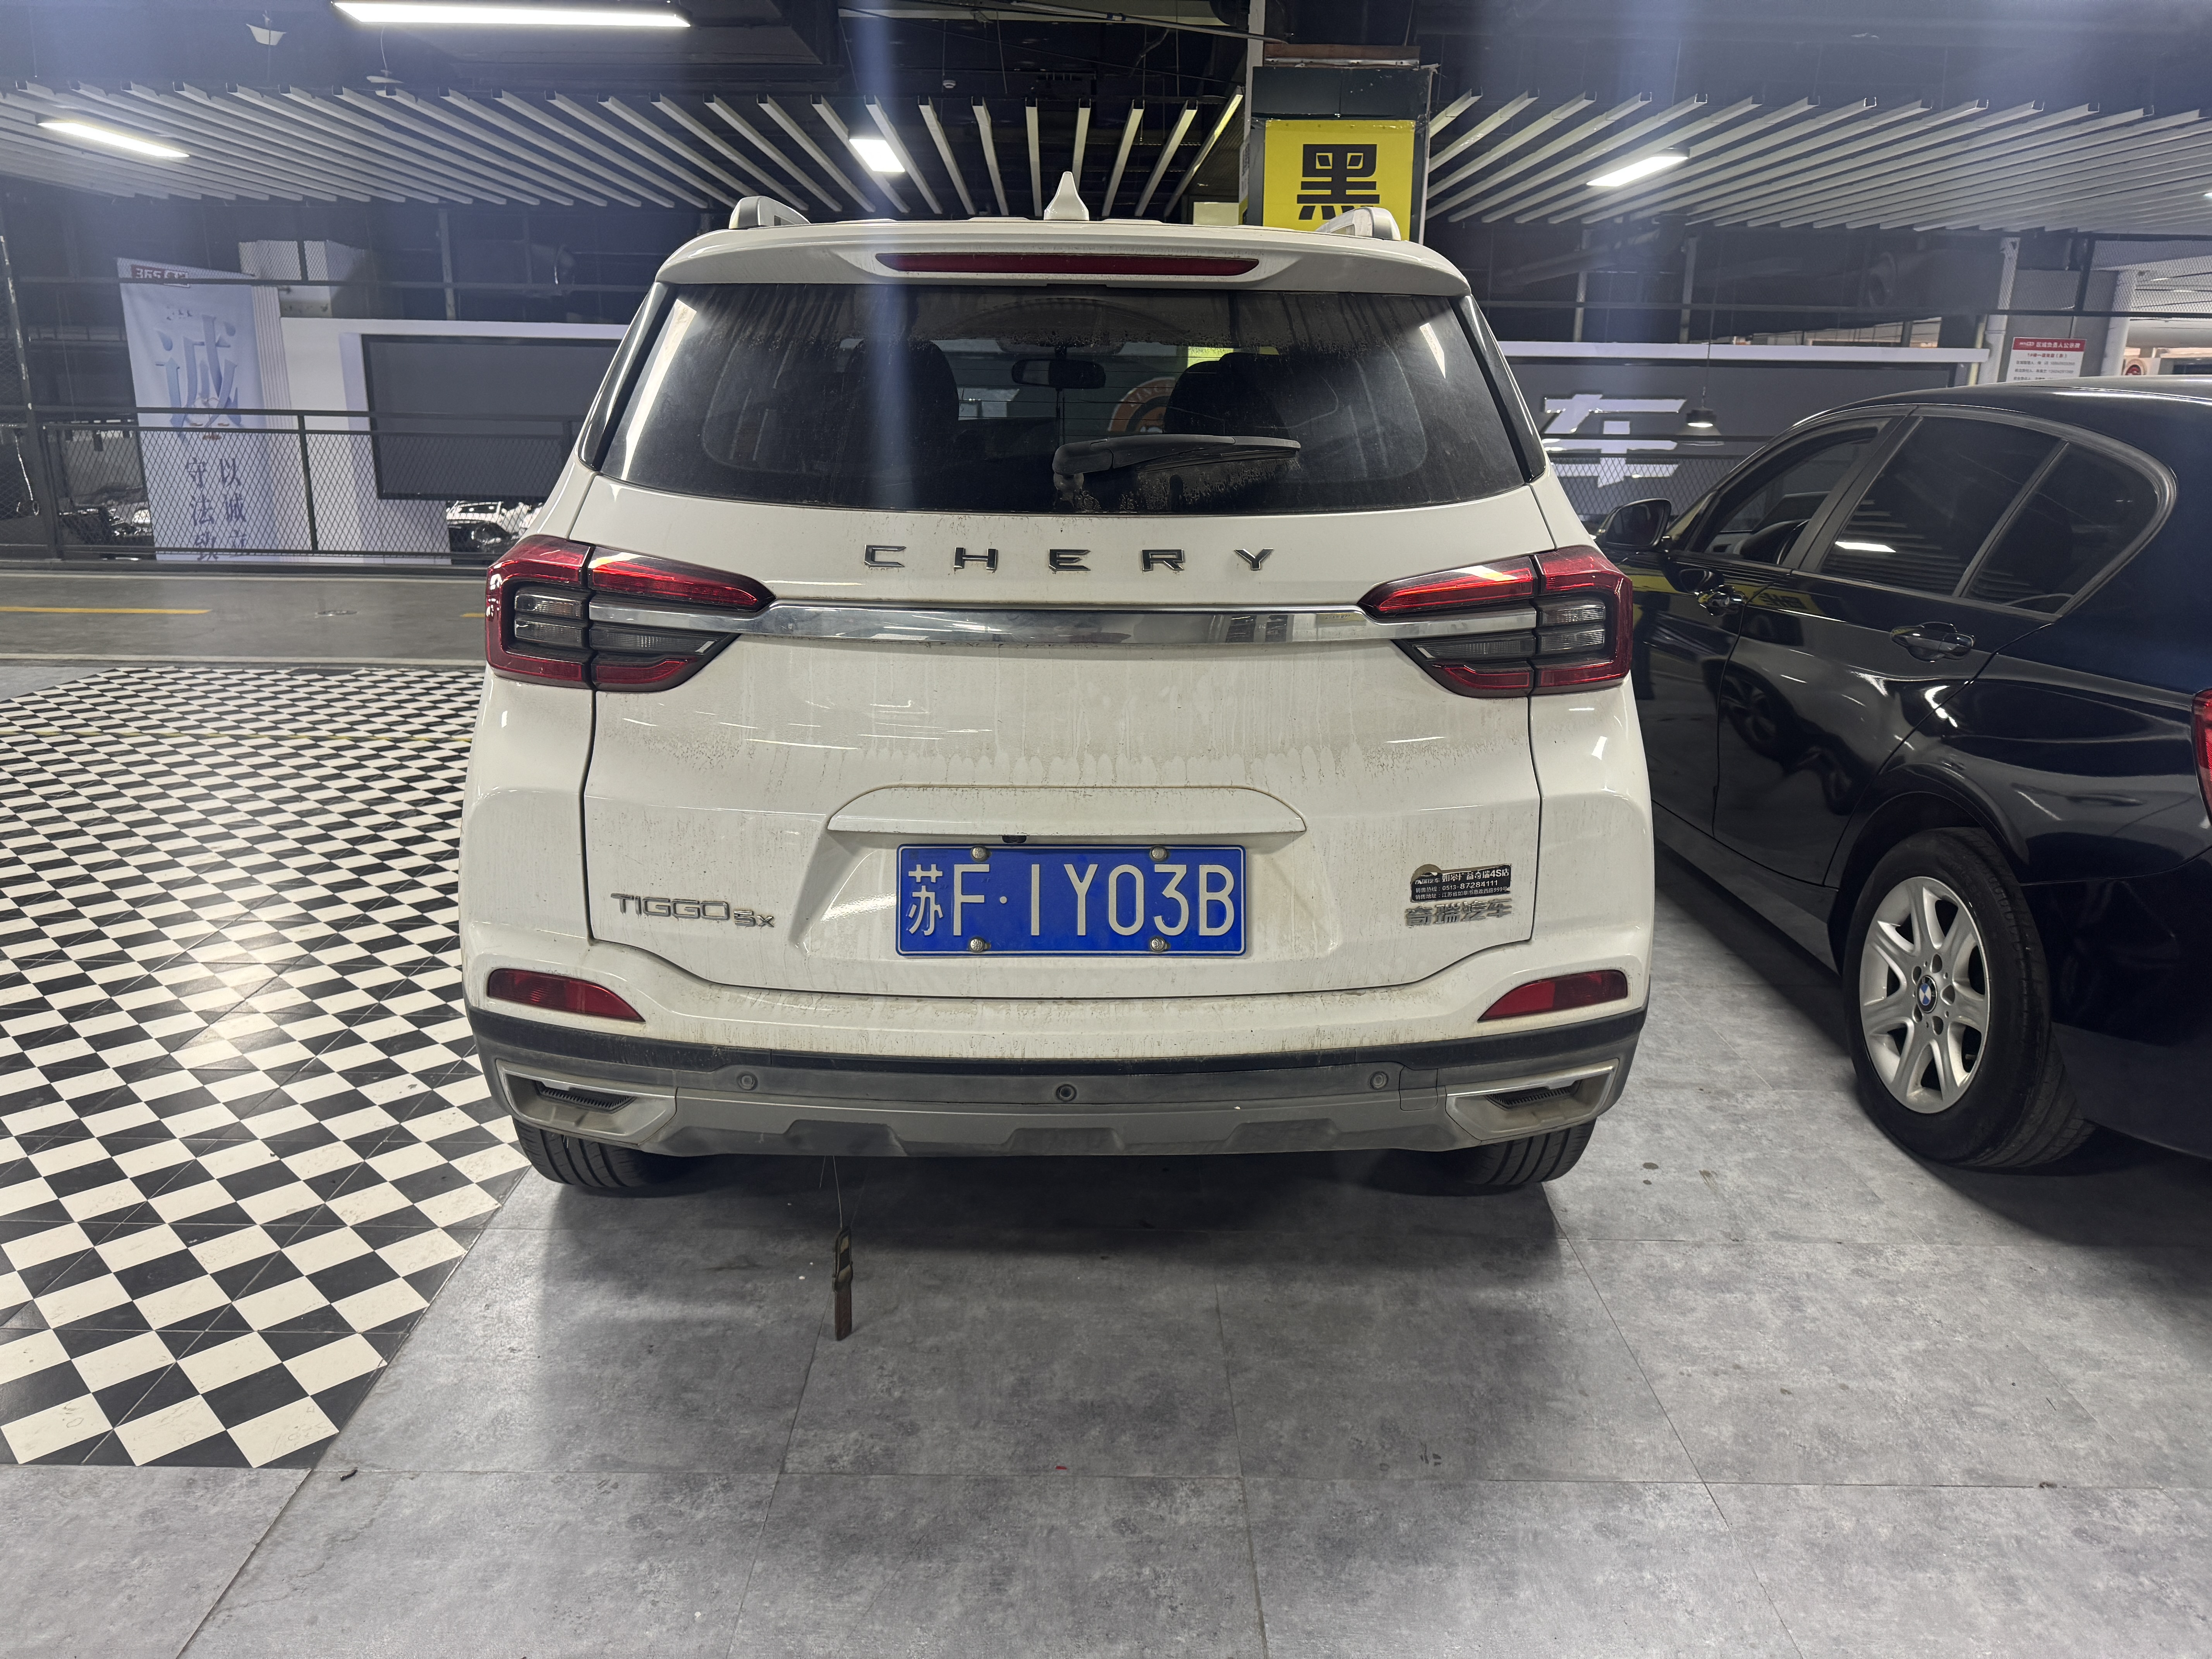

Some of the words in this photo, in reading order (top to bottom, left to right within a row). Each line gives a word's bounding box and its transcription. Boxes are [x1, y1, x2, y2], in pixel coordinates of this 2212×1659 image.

[1297, 144, 1380, 220] 黑
[155, 314, 244, 444] 诚
[864, 544, 1275, 571] CHERY
[611, 893, 730, 921] TIGGO
[908, 864, 1235, 936] 苏F·1Y03B
[1405, 898, 1512, 927] 奇瑞汽车
